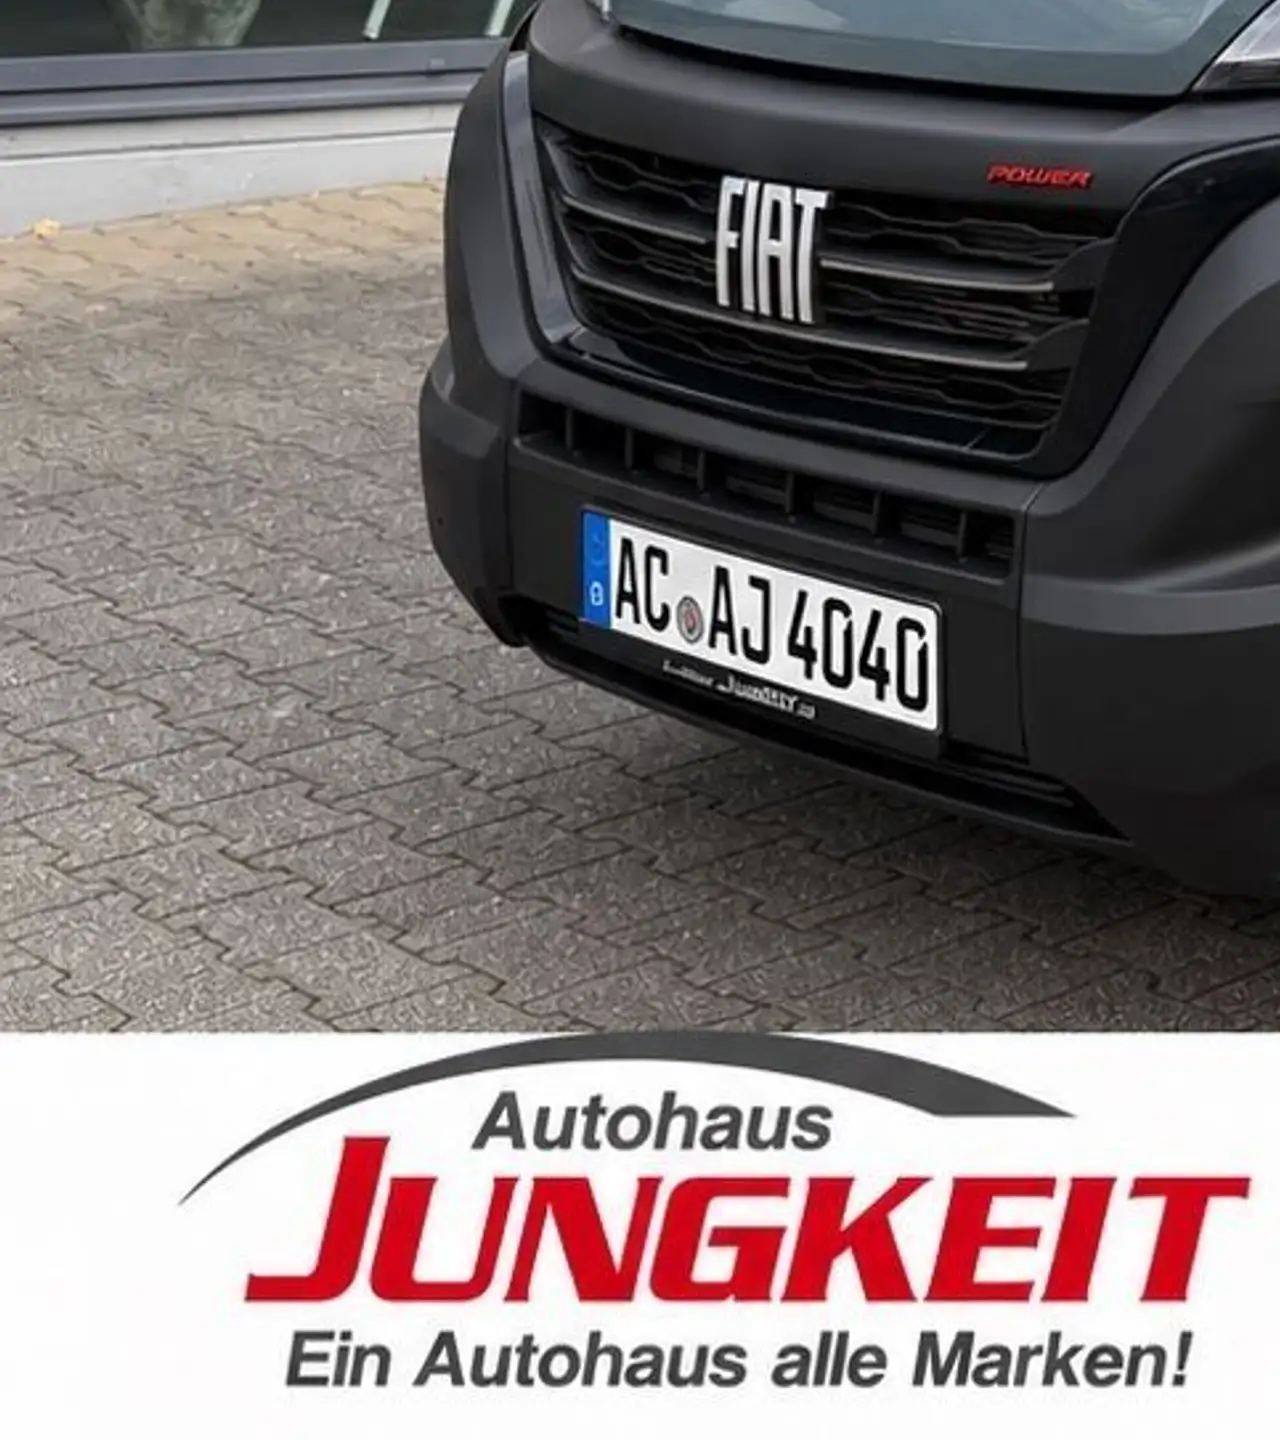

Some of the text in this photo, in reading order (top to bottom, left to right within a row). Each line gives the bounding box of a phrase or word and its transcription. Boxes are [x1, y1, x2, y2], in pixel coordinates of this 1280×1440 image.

[714, 174, 832, 325] FIAT
[986, 163, 1095, 190] POWER
[614, 536, 930, 713] AC AJ 4040
